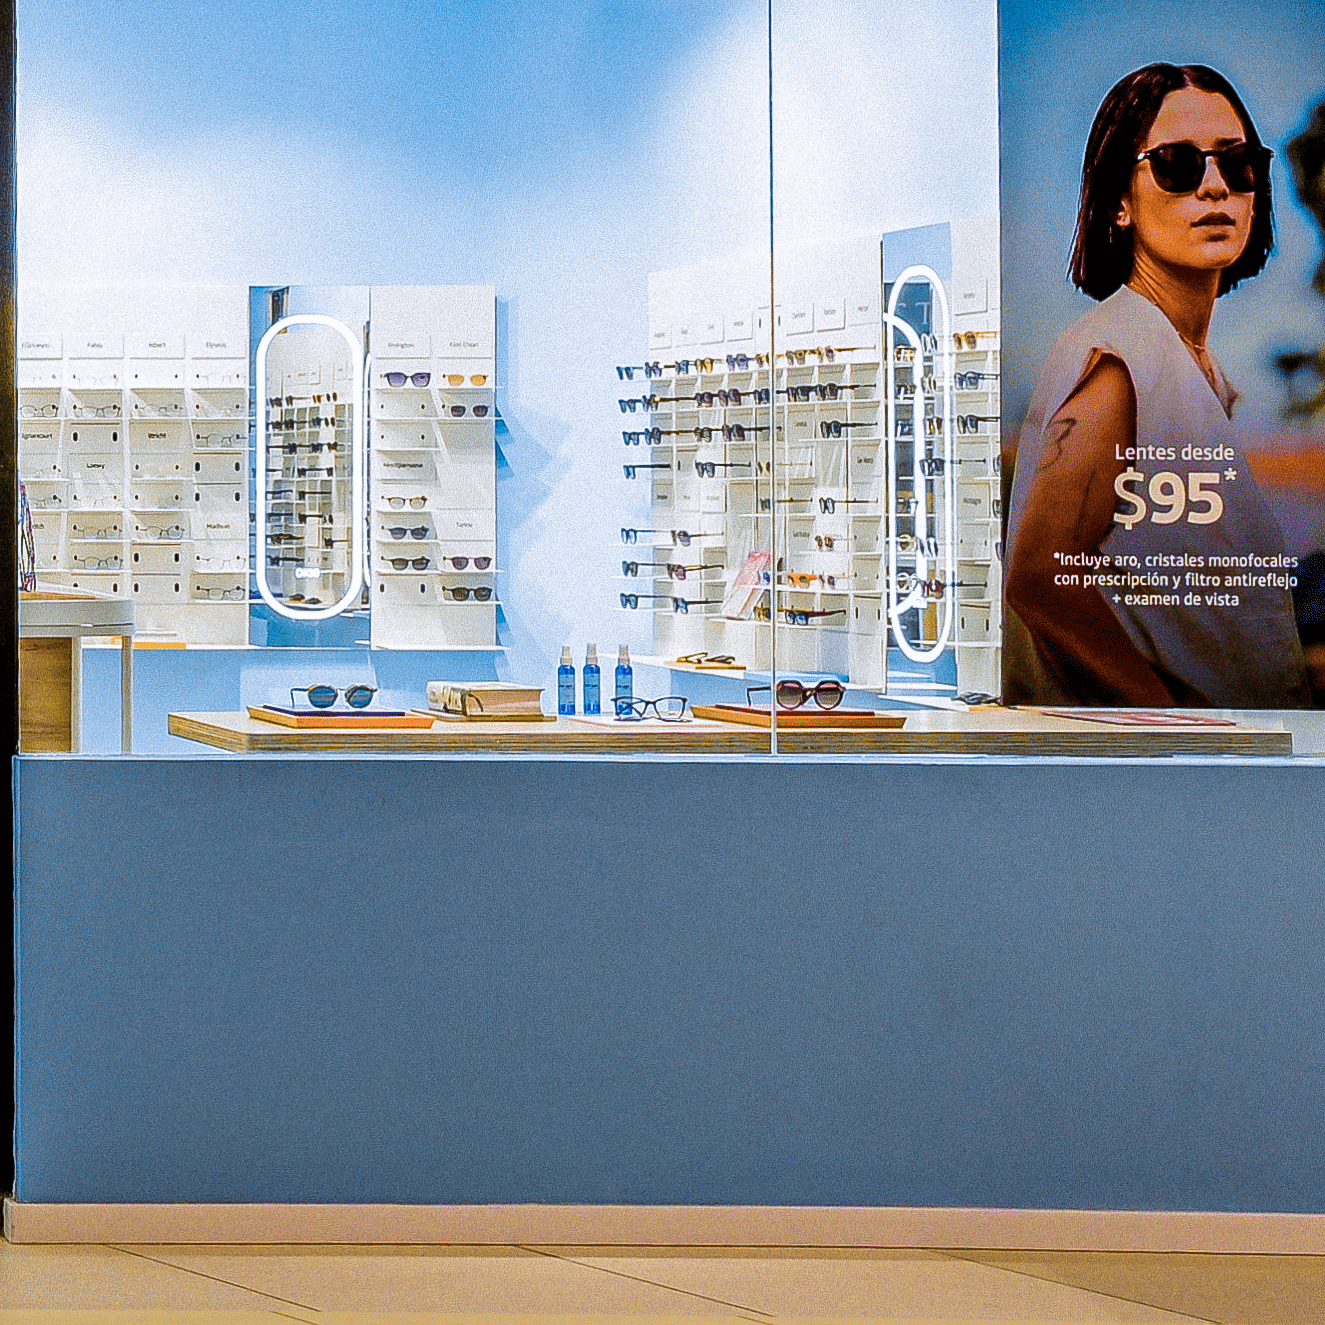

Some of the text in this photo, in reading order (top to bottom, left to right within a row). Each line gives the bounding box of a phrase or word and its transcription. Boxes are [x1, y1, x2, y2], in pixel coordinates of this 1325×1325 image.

[1115, 443, 1235, 461] Lentes desde
[1114, 555, 1142, 569] aro,
[1145, 553, 1205, 567] cristales
[1208, 553, 1298, 567] monofocales
[1054, 572, 1298, 590] con prescripción y filtro antireflejo
[1124, 595, 1180, 607] examen
[1184, 593, 1201, 607] de
[1204, 593, 1239, 607] vista
